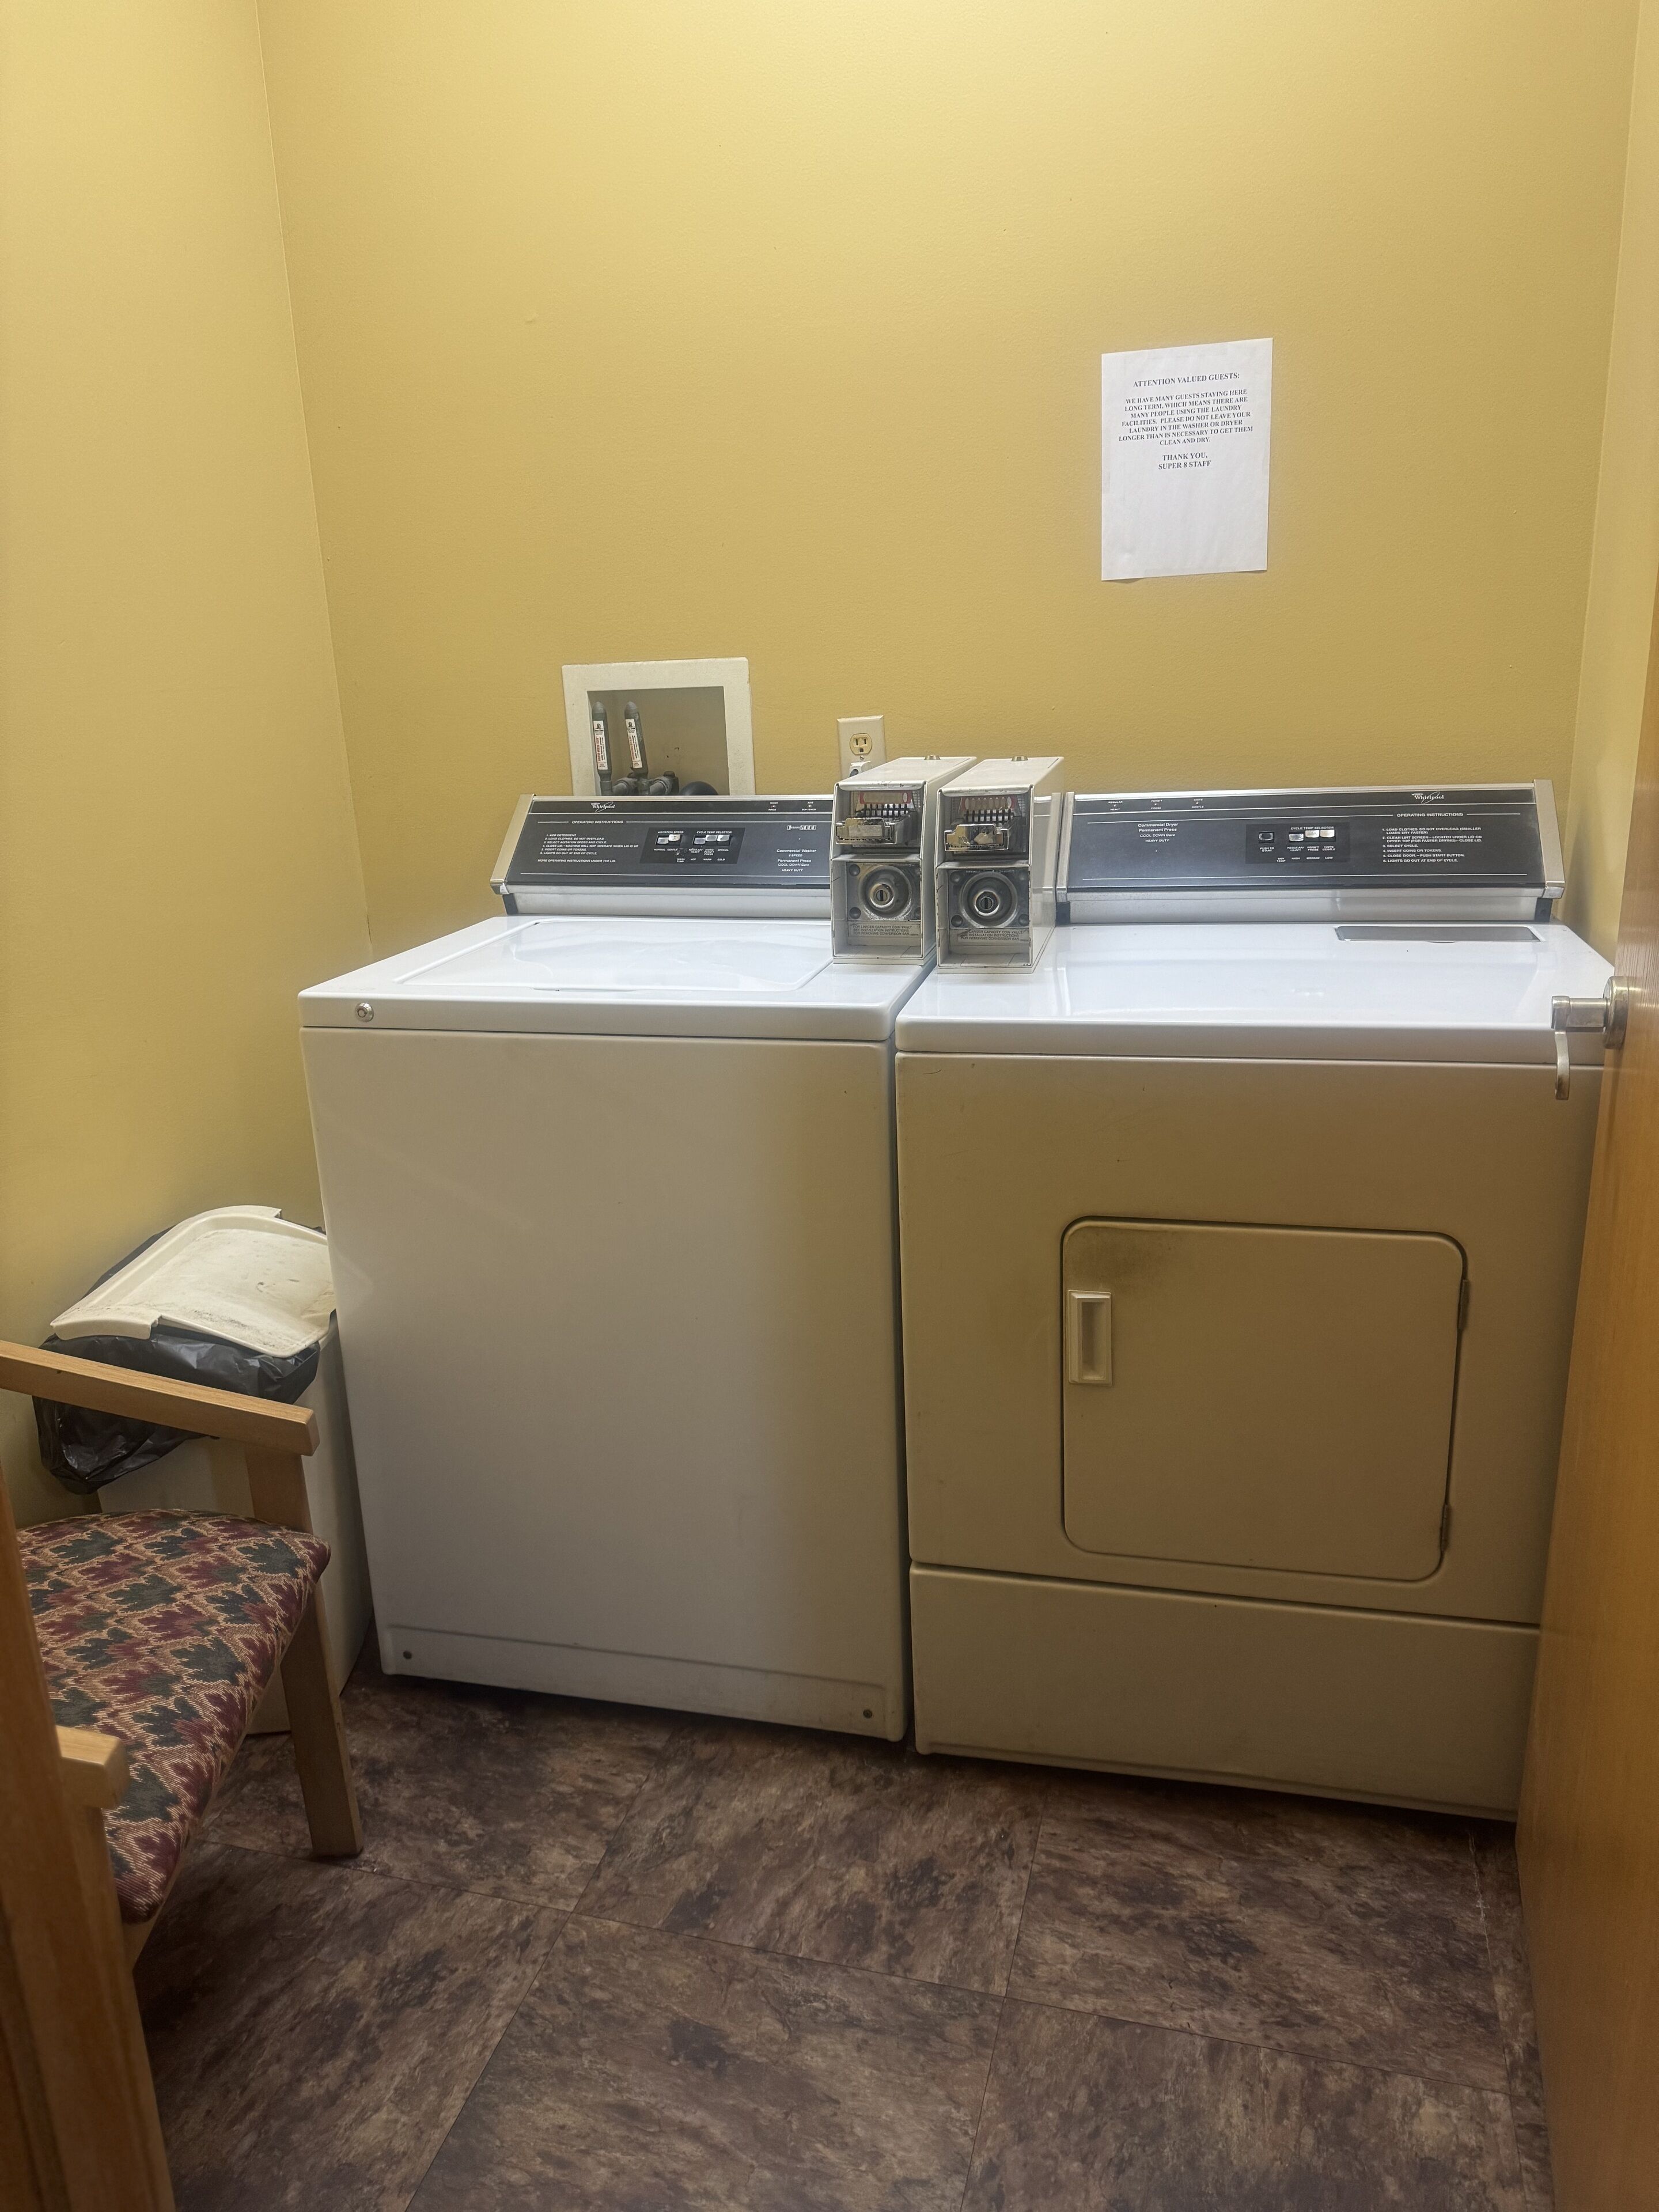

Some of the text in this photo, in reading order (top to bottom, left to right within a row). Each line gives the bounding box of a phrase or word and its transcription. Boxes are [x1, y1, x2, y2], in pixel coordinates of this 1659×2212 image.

[1134, 378, 1175, 387] ATTENTION
[1178, 375, 1207, 384] VALUED
[1412, 793, 1444, 801] Whirlpool
